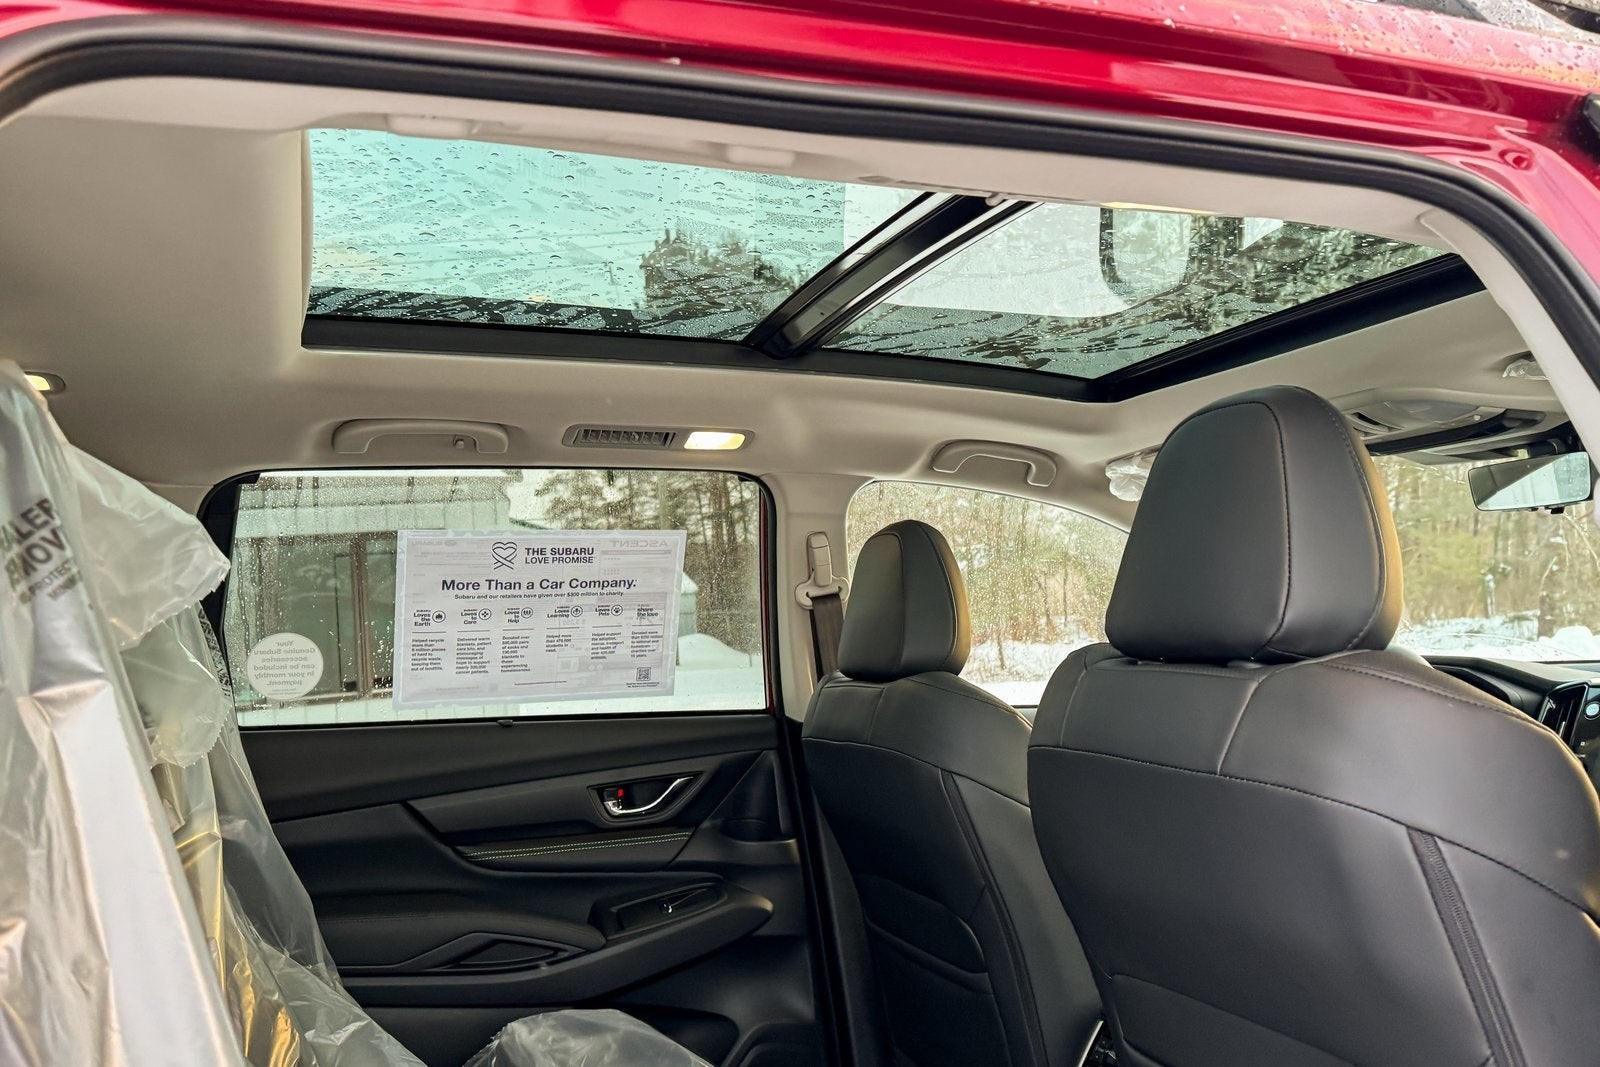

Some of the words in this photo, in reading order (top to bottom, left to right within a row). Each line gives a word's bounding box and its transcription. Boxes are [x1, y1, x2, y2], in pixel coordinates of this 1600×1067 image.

[442, 580, 480, 590] More
[485, 579, 521, 590] Than
[540, 579, 564, 589] Car
[569, 578, 636, 590] Company.
